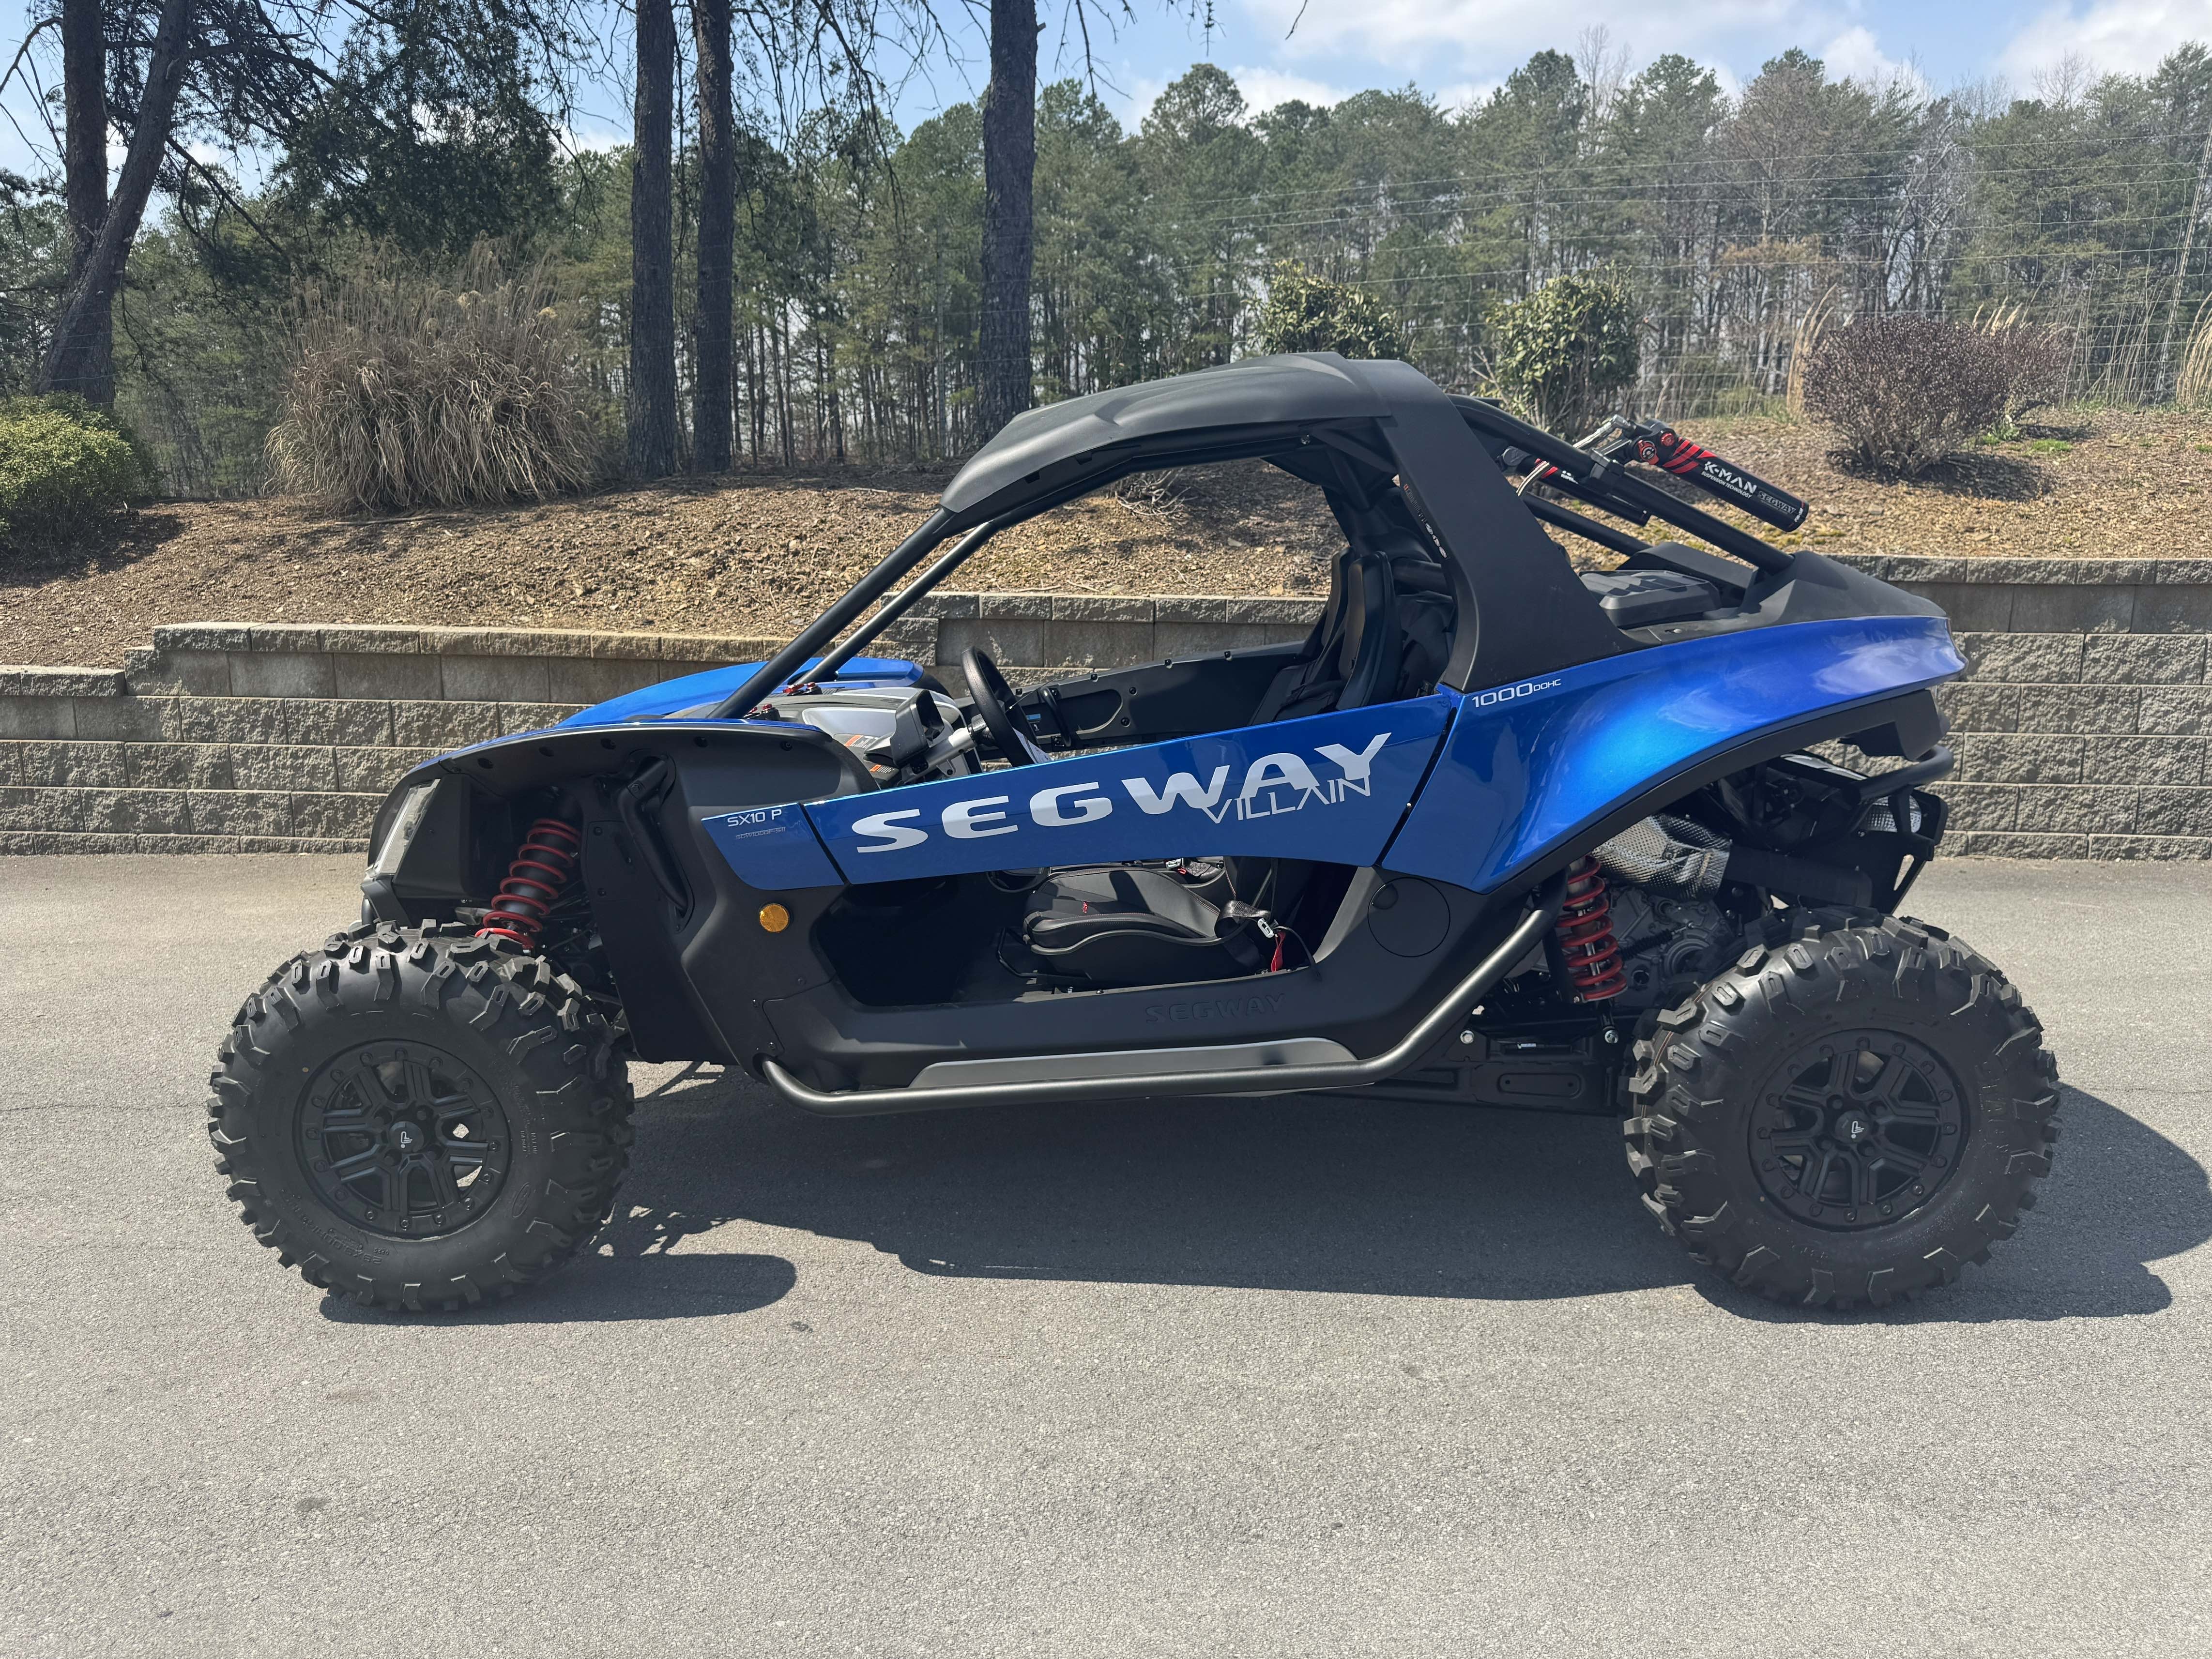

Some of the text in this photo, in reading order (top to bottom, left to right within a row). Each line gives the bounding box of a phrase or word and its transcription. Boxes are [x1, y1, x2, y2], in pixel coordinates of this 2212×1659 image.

[1701, 471, 1753, 499] SUSPENSION TECHNOLOGY
[1757, 490, 1797, 514] SEGWAY
[852, 732, 1392, 853] SEGWAY
[1201, 775, 1371, 824] VILLAIN
[727, 809, 782, 827] SX10 P
[1145, 993, 1284, 1023] SEGWAY
